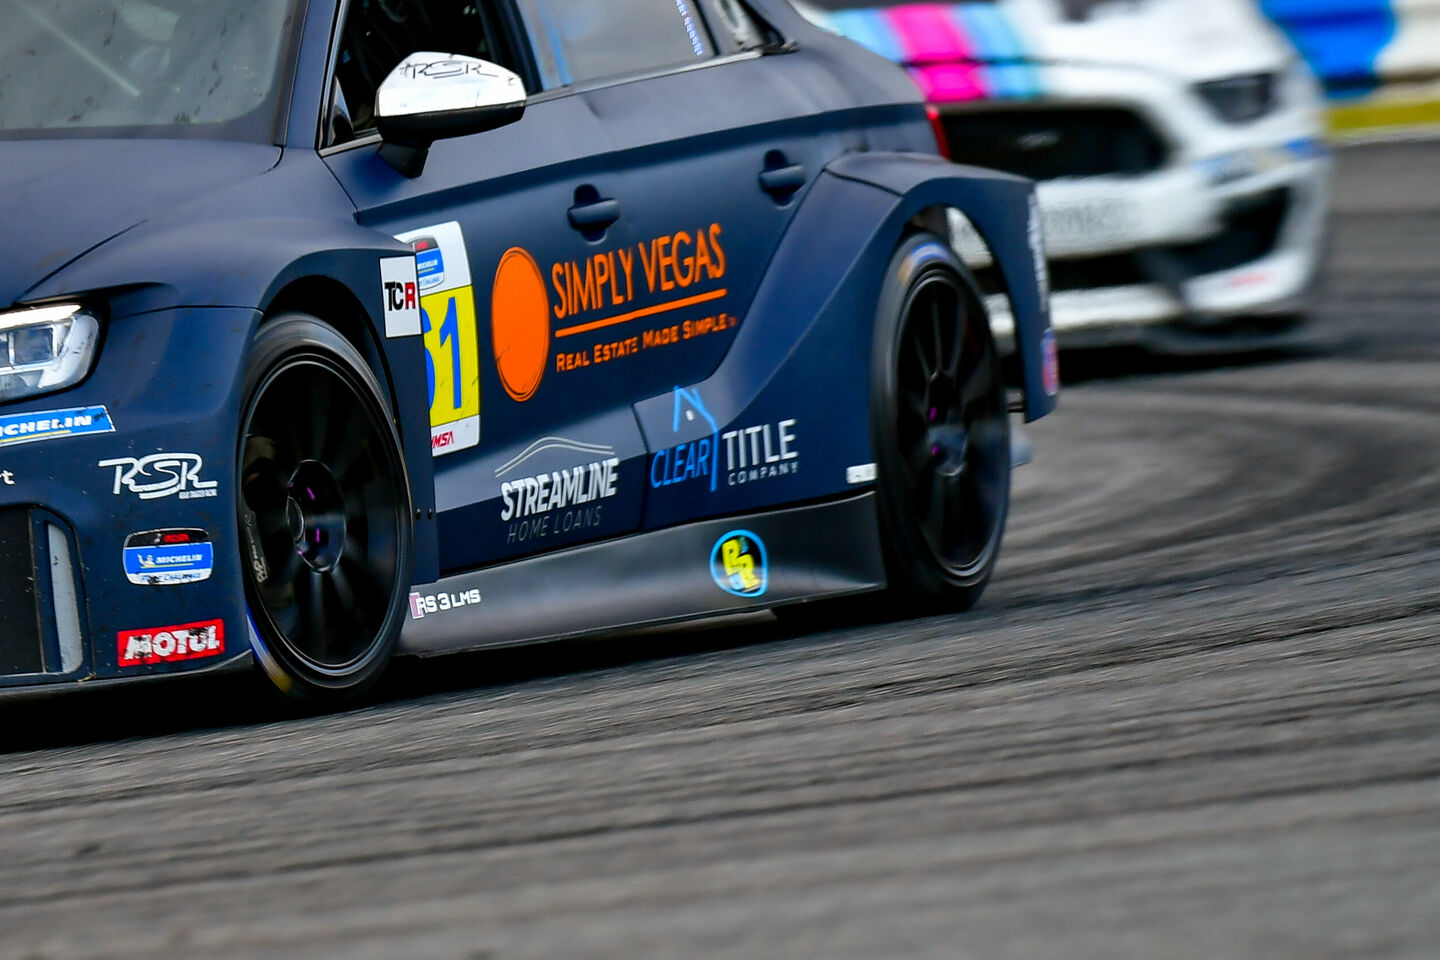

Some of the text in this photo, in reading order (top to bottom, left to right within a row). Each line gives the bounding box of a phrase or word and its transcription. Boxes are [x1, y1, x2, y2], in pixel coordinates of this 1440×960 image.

[552, 223, 726, 319] SIMPLY VEGAS
[384, 281, 417, 311] TCR
[556, 313, 728, 373] REAL ESTATE MADE SIMPLE
[650, 418, 800, 489] CLEAR TITLE
[727, 461, 800, 487] COMPANY
[98, 452, 218, 500] RSR
[501, 457, 620, 522] STREAMLINE
[507, 505, 603, 544] HOME LOANS
[155, 553, 203, 564] MICHELIN
[123, 625, 221, 660] MOTUL
